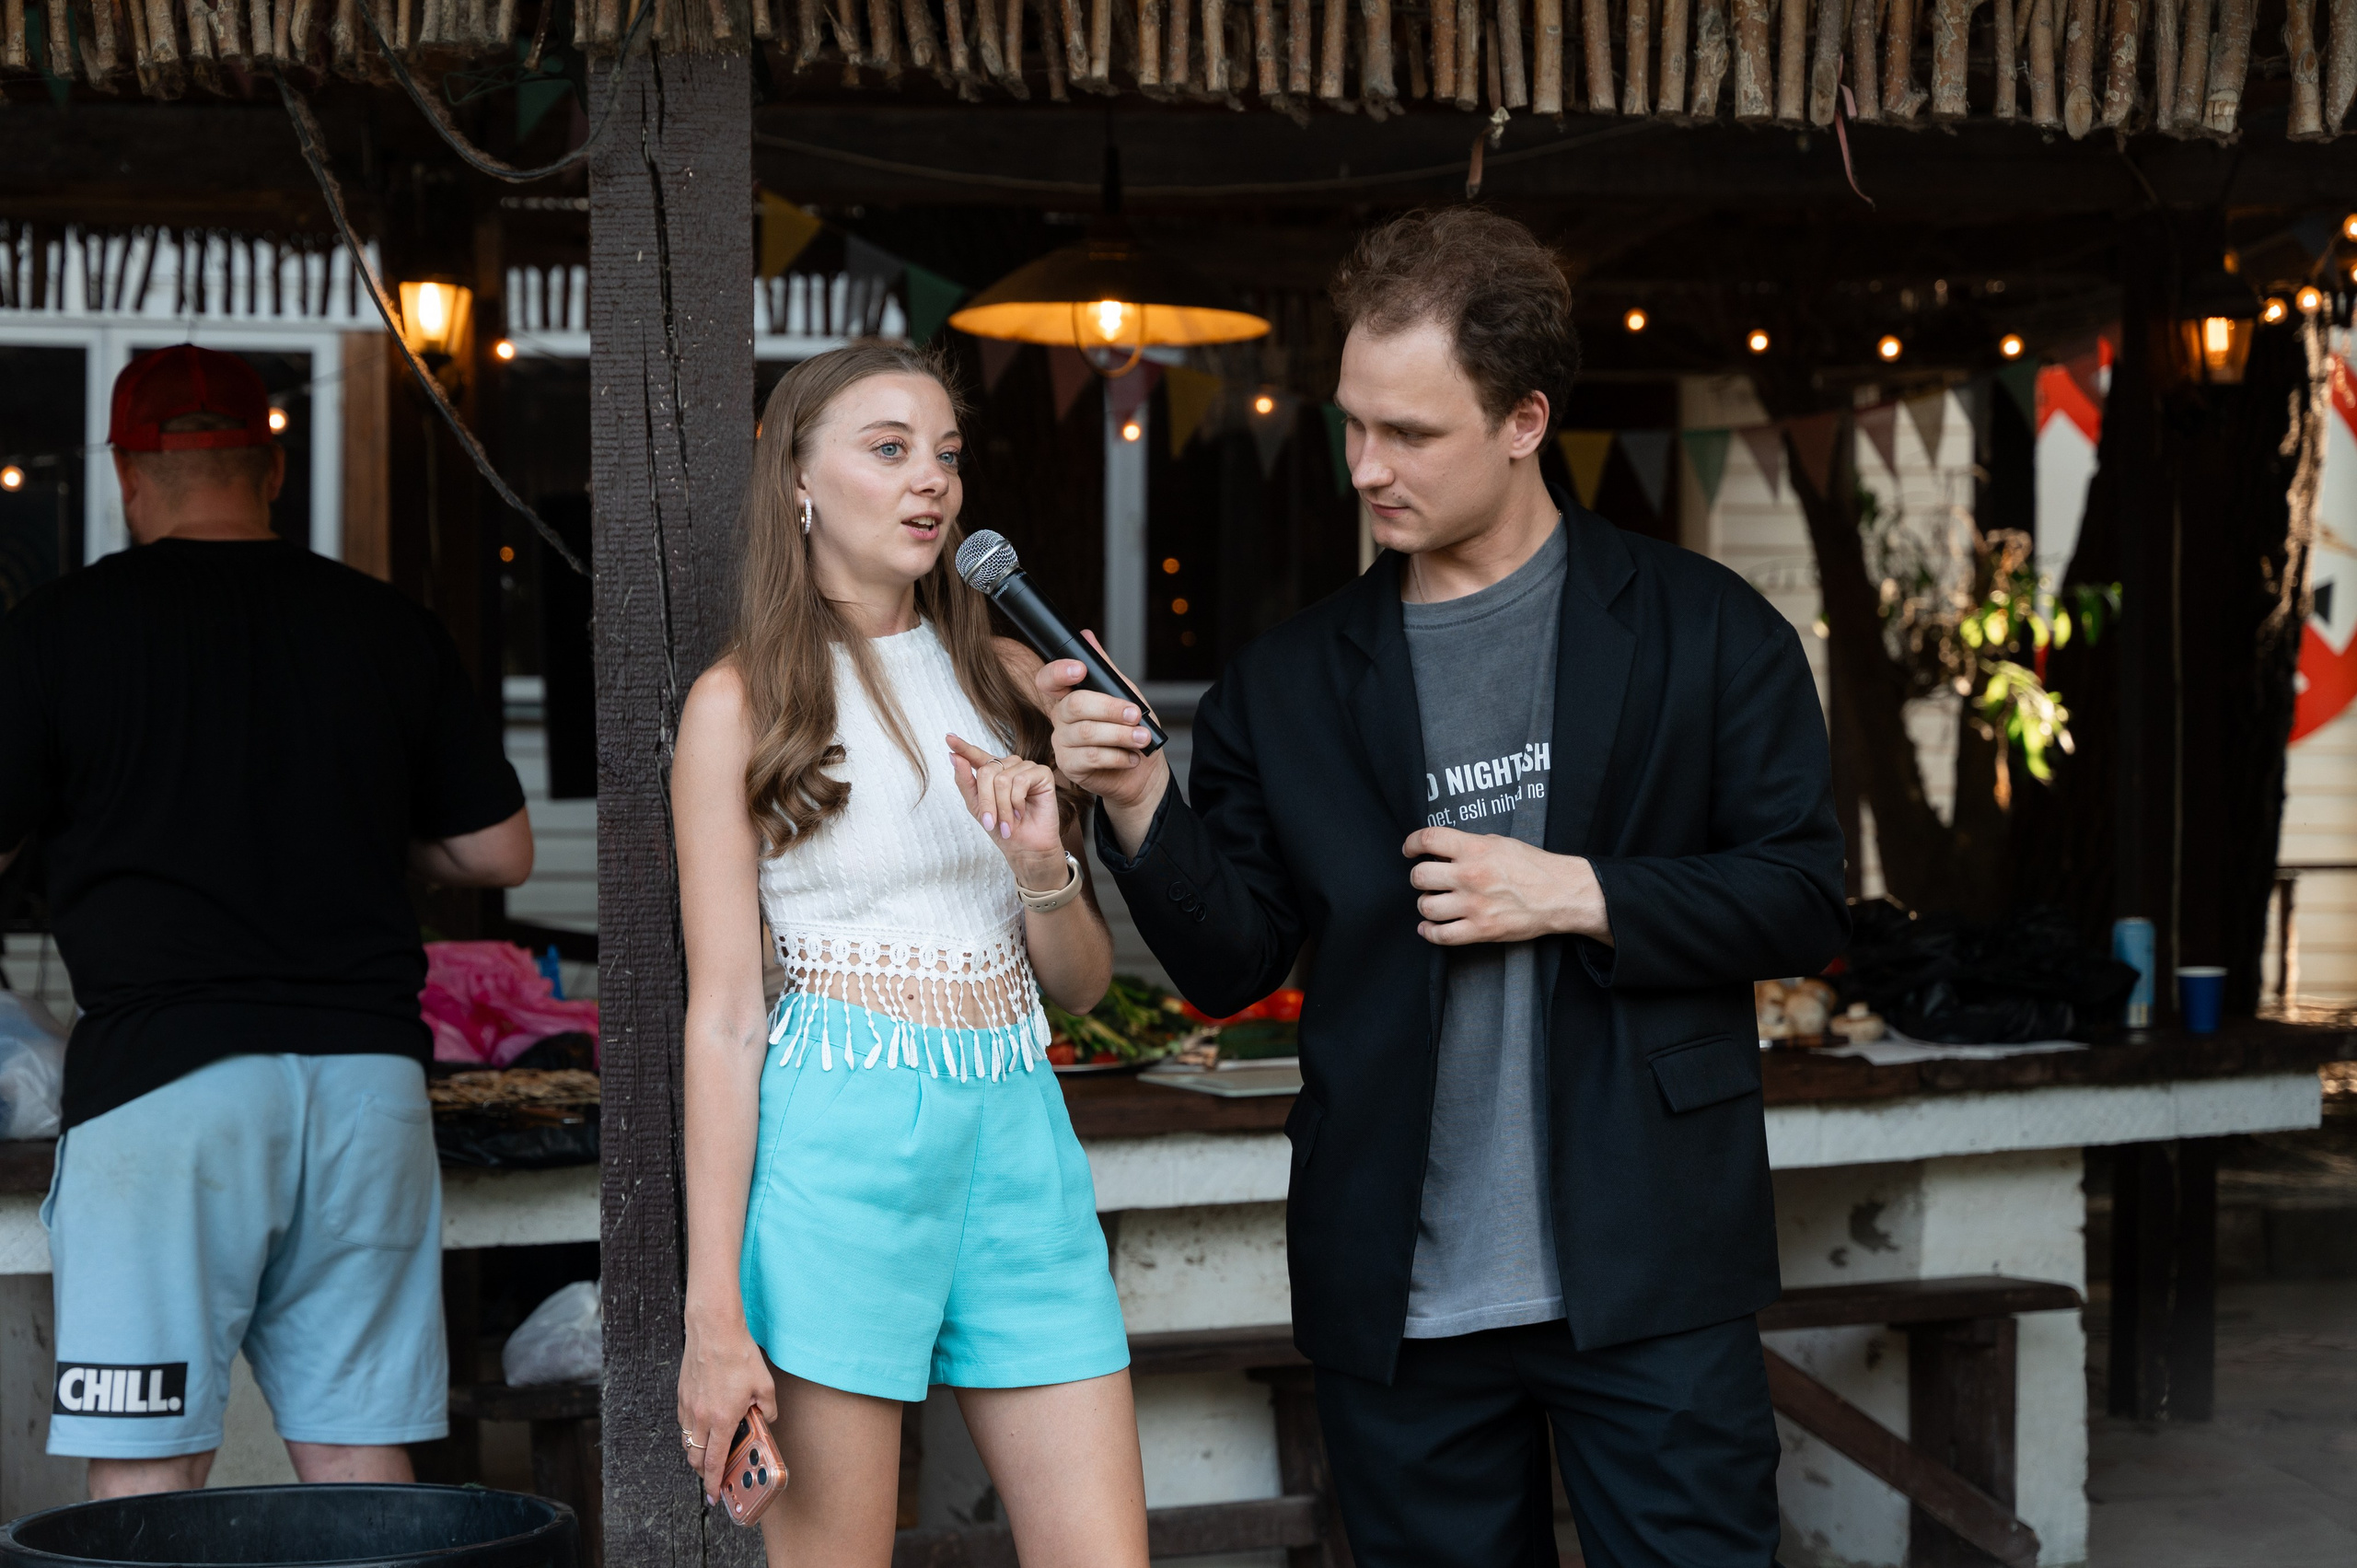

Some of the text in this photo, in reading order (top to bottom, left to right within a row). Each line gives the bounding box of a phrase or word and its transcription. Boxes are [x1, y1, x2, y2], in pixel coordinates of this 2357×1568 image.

[1458, 797, 1487, 820] esli
[1527, 783, 1544, 799] ne
[58, 1366, 181, 1412] CHILL.
